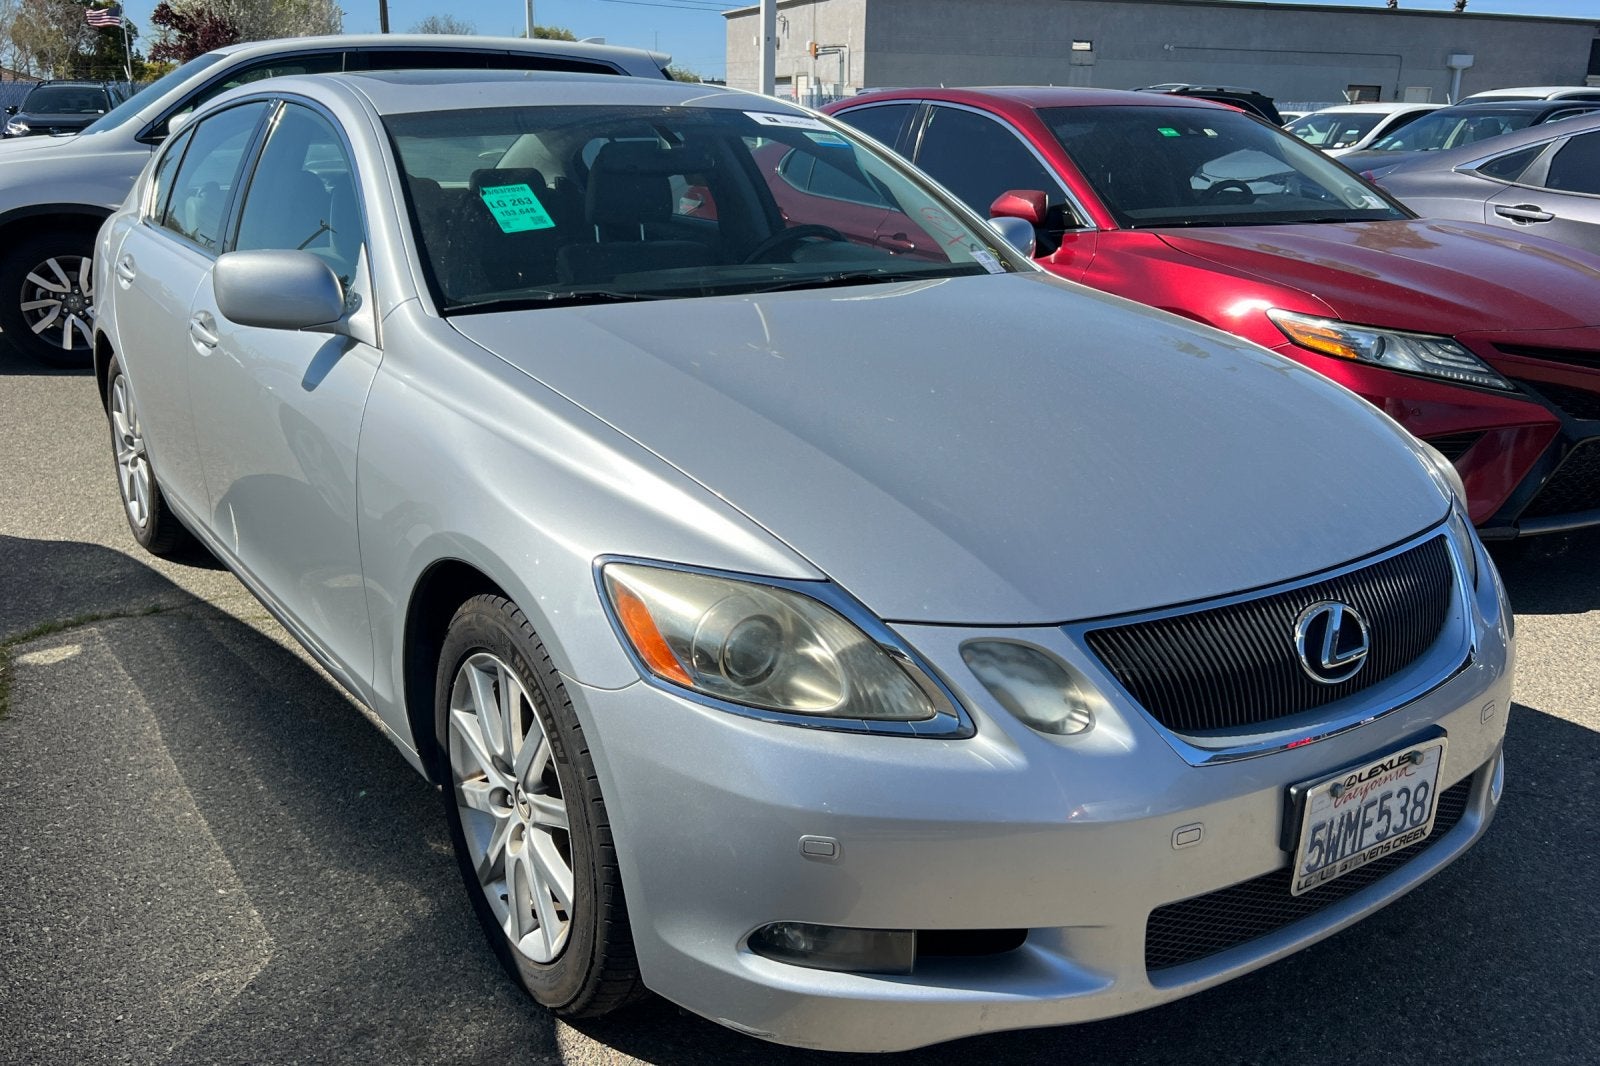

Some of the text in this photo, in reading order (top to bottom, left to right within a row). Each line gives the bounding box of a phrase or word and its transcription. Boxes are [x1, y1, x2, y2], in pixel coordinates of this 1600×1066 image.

[489, 197, 533, 209] LG 263
[513, 652, 566, 759] MICHELIN
[1334, 766, 1416, 809] California
[1357, 751, 1413, 784] LEXUS
[1305, 781, 1430, 874] 5WMF538
[1297, 826, 1428, 892] LEXUS STEVENS CREEK
